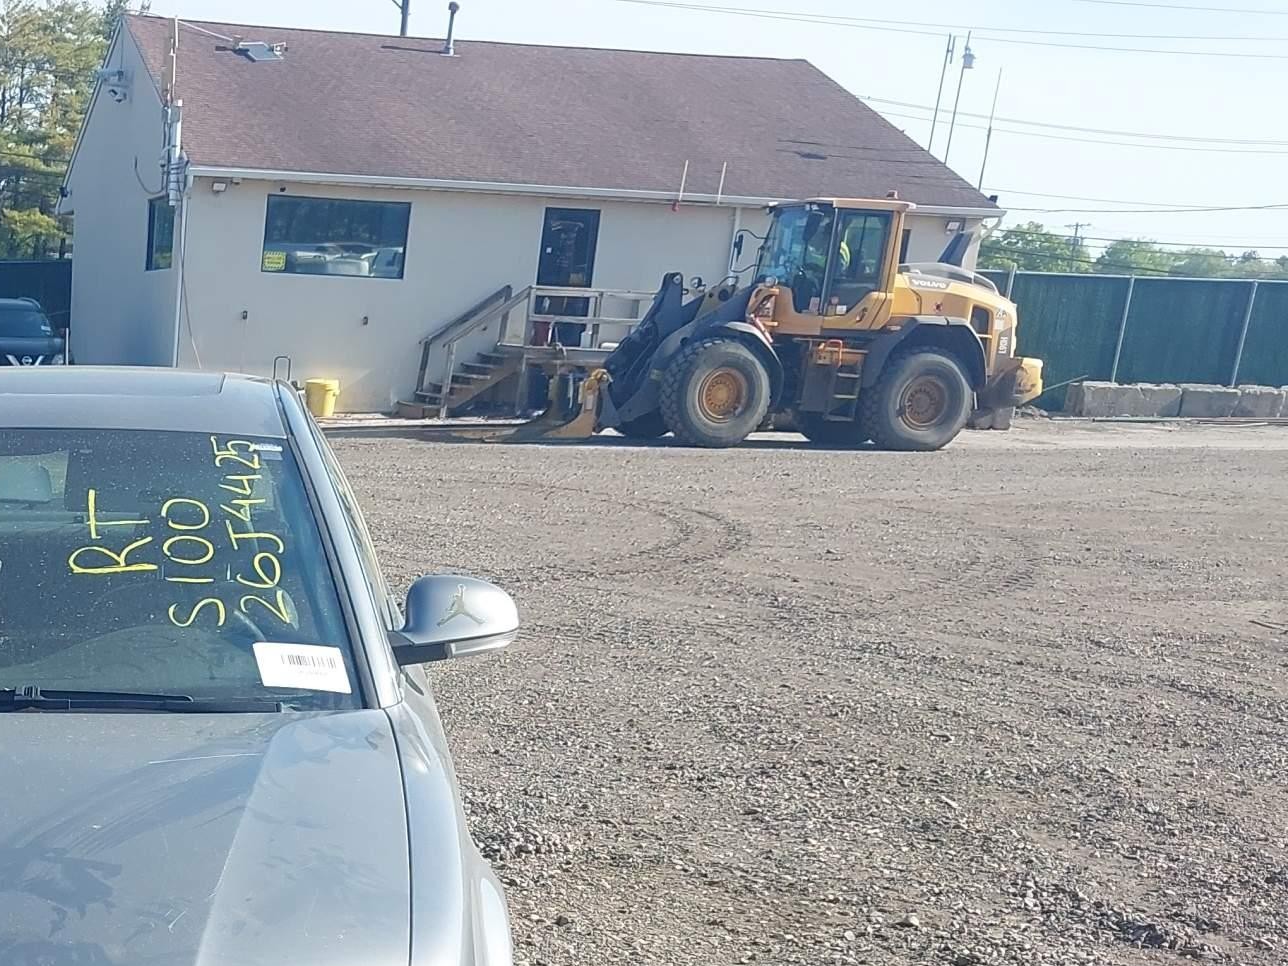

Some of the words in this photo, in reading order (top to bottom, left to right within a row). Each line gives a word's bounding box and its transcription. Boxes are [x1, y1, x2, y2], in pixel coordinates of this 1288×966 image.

[912, 279, 948, 289] VOLVO
[68, 488, 158, 574] RT
[161, 498, 226, 628] S100
[210, 435, 290, 625] 26J4425
